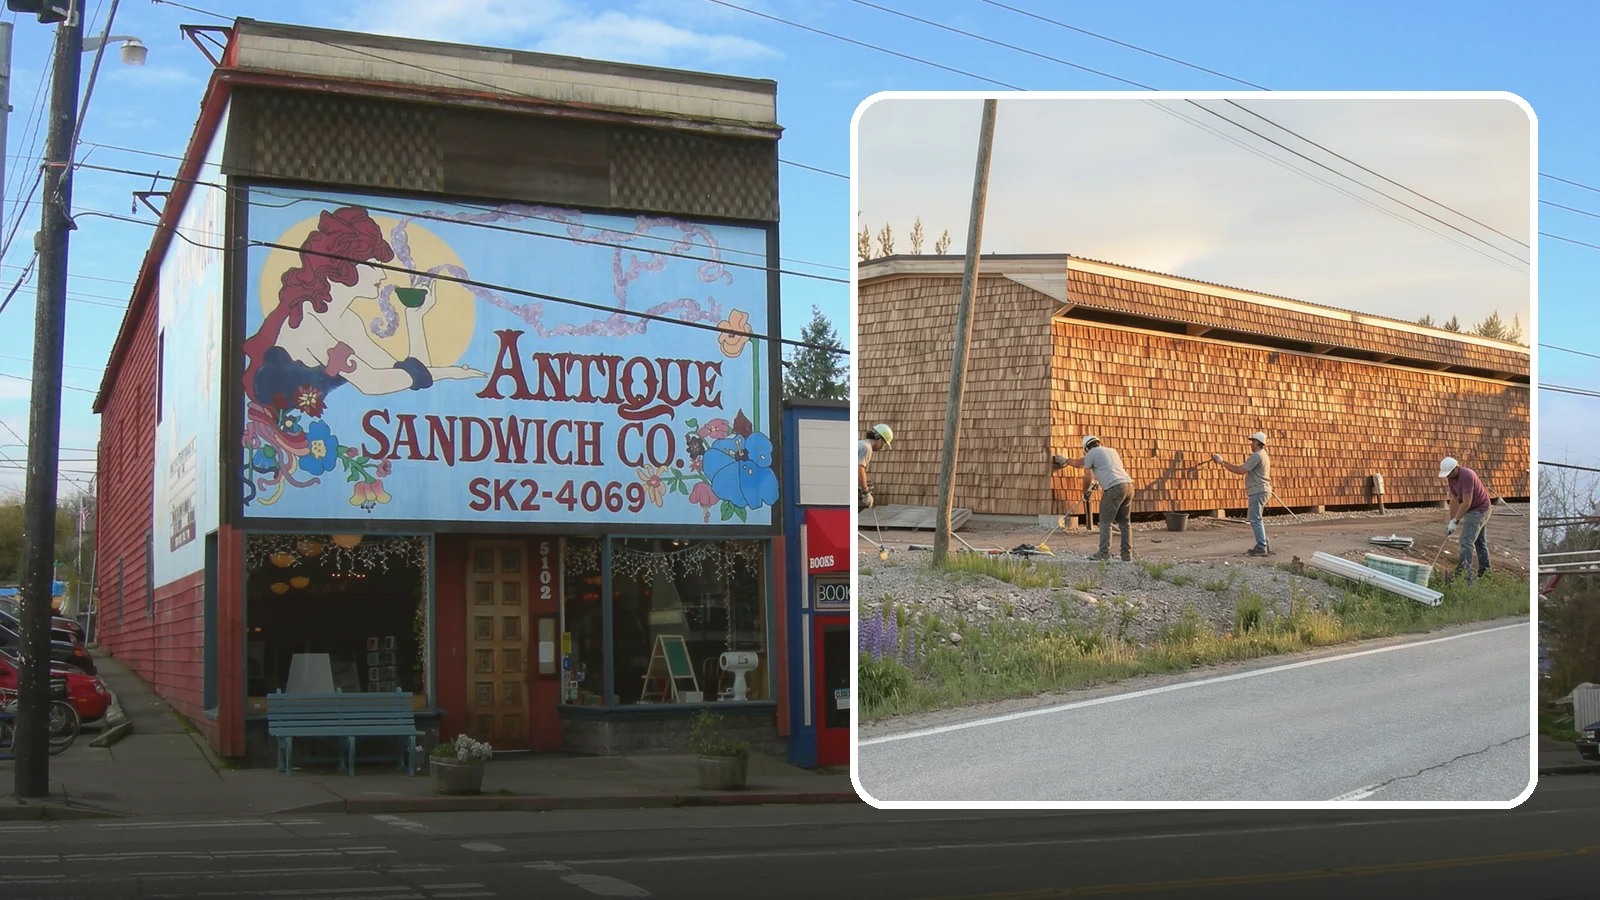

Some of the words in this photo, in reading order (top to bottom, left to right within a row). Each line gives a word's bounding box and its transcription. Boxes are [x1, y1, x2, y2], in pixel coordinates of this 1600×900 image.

[475, 328, 723, 421] ANTIQUE
[361, 408, 605, 467] SANDWICH
[617, 421, 685, 469] CO.
[468, 476, 646, 513] SK2-4069
[539, 541, 552, 600] 5102
[809, 555, 835, 569] BOOKS
